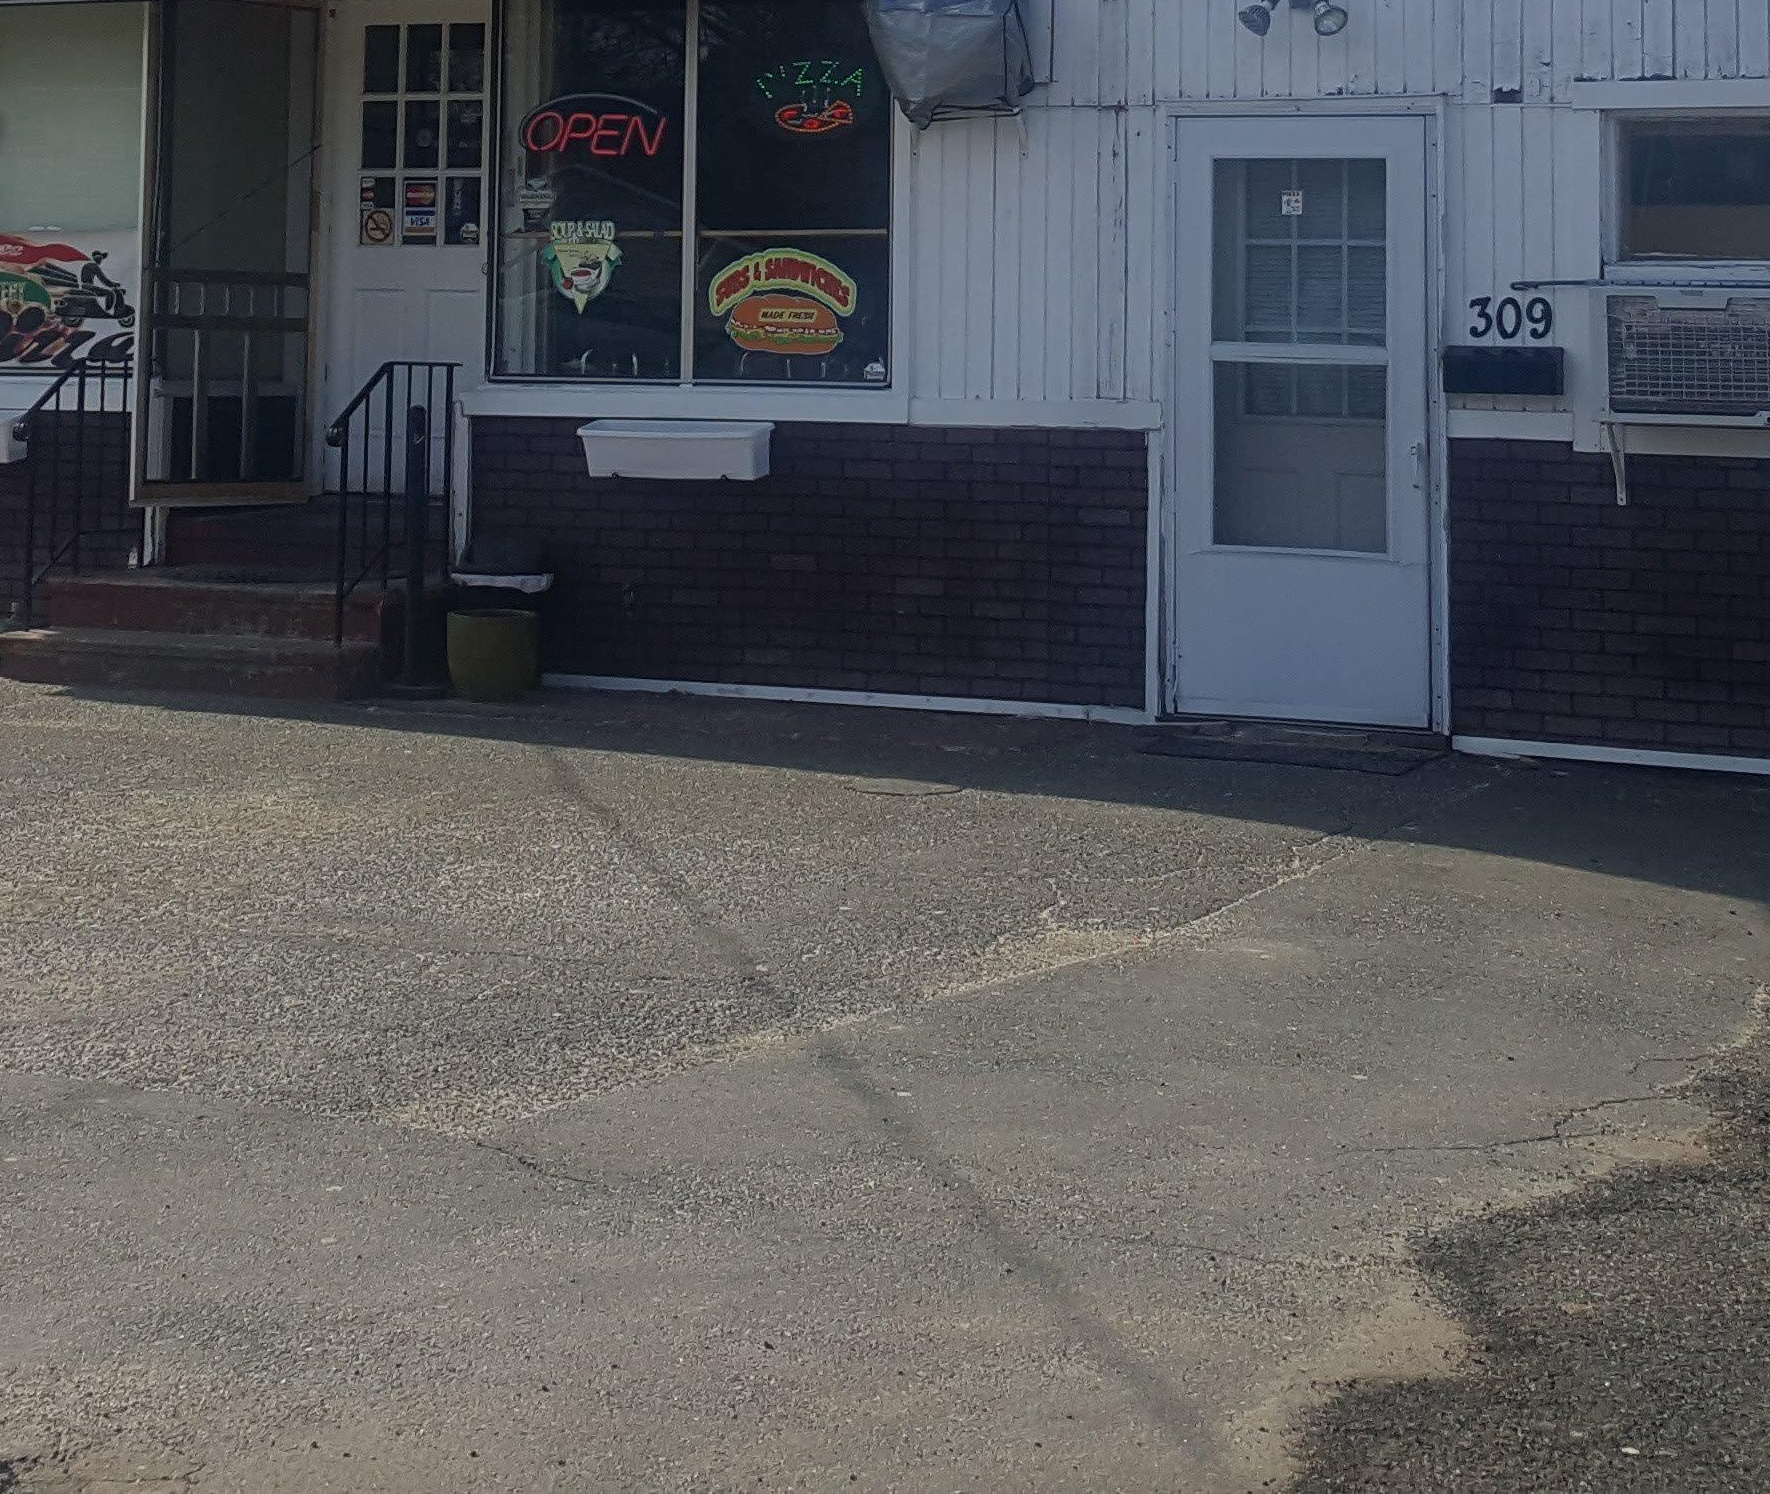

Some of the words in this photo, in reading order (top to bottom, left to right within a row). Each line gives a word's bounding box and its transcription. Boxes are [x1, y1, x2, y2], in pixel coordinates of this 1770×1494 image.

[526, 110, 668, 157] OPEN
[410, 216, 430, 226] VISA
[586, 221, 616, 241] SALAD
[760, 310, 785, 320] MADE
[1469, 296, 1553, 340] 309
